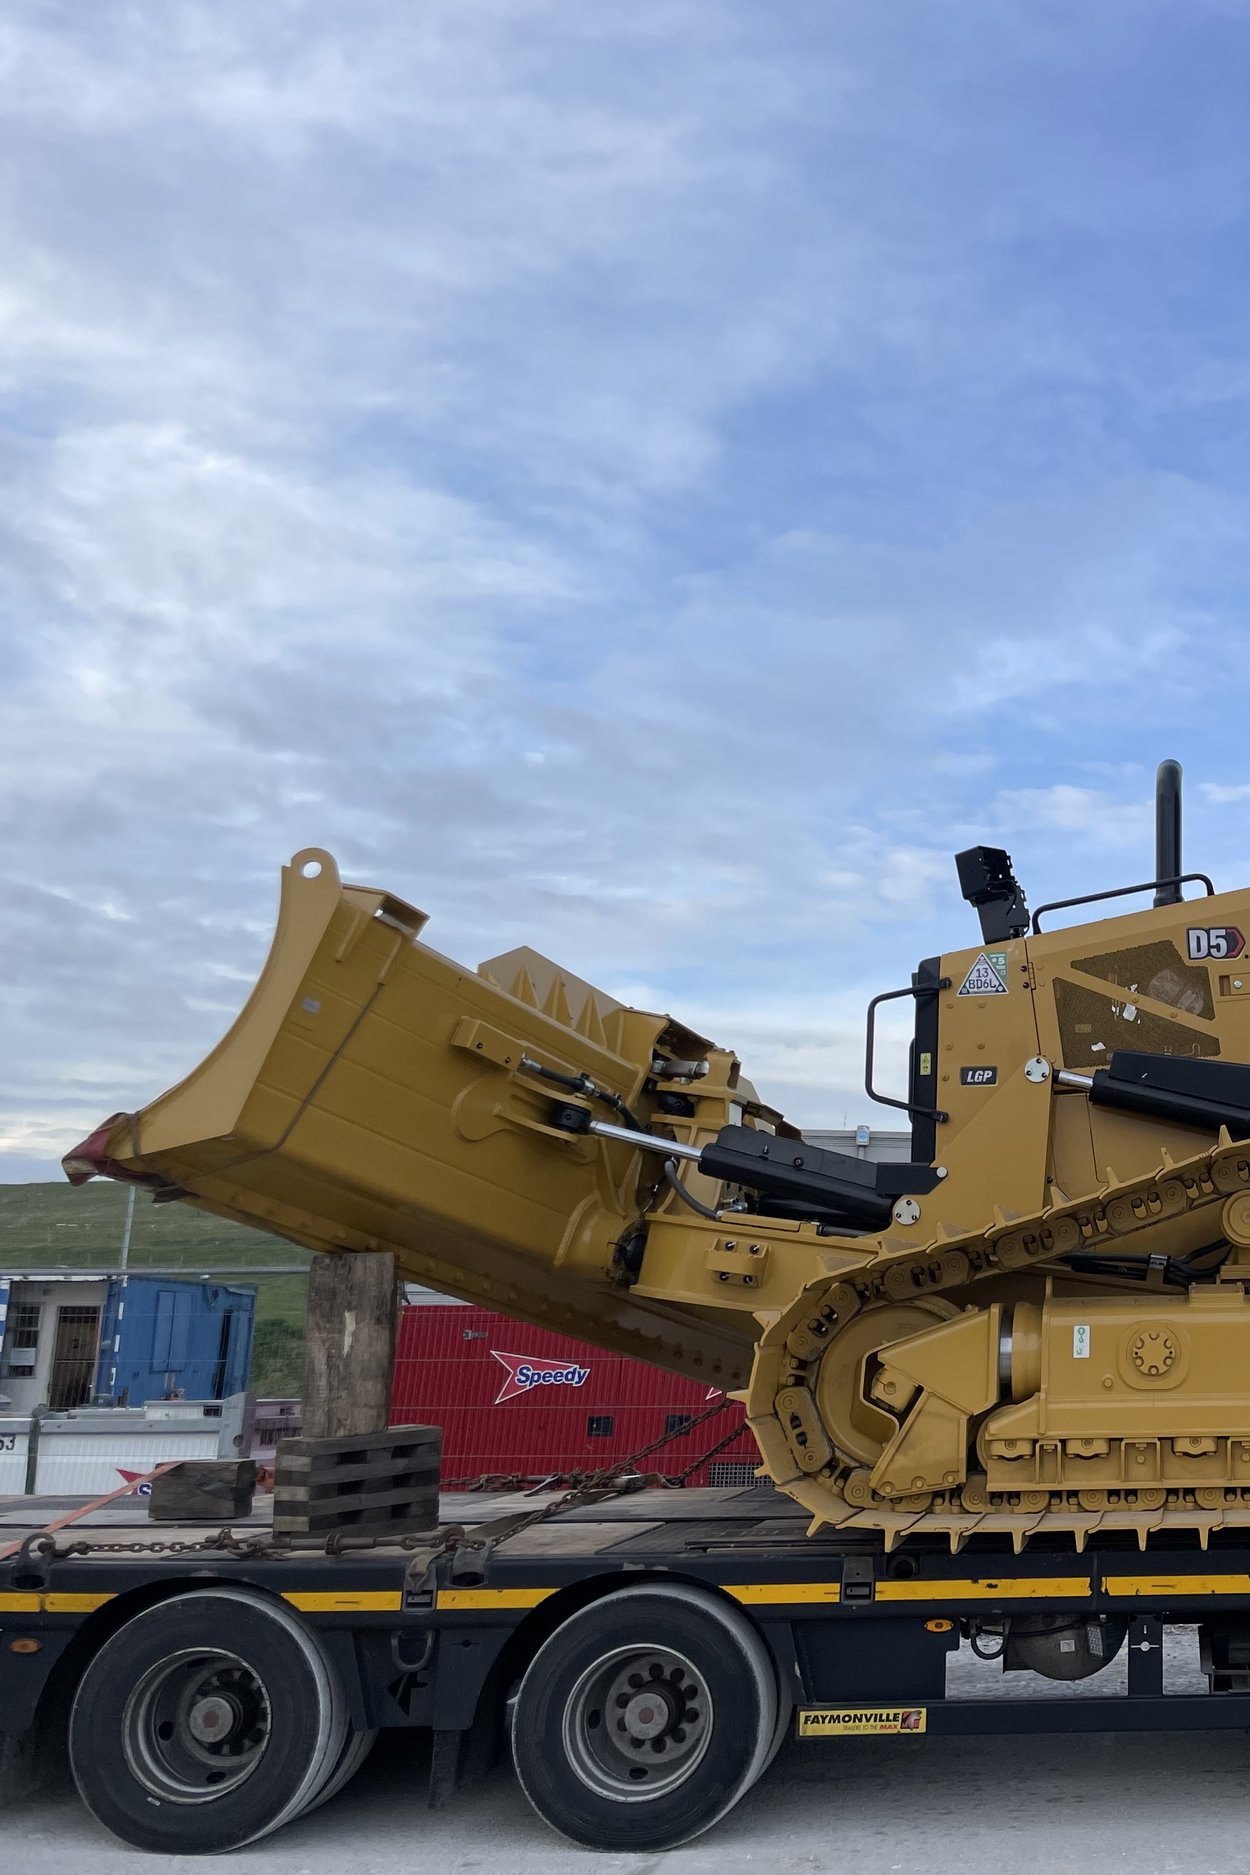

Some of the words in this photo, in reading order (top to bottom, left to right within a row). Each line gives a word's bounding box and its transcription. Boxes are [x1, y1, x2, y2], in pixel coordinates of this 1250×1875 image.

[1188, 929, 1228, 959] D5
[975, 967, 989, 979] 13
[968, 978, 997, 990] BD6L
[966, 1070, 993, 1083] LGP
[516, 1364, 590, 1387] Speedy
[803, 1712, 901, 1725] FAYMONVILLE
